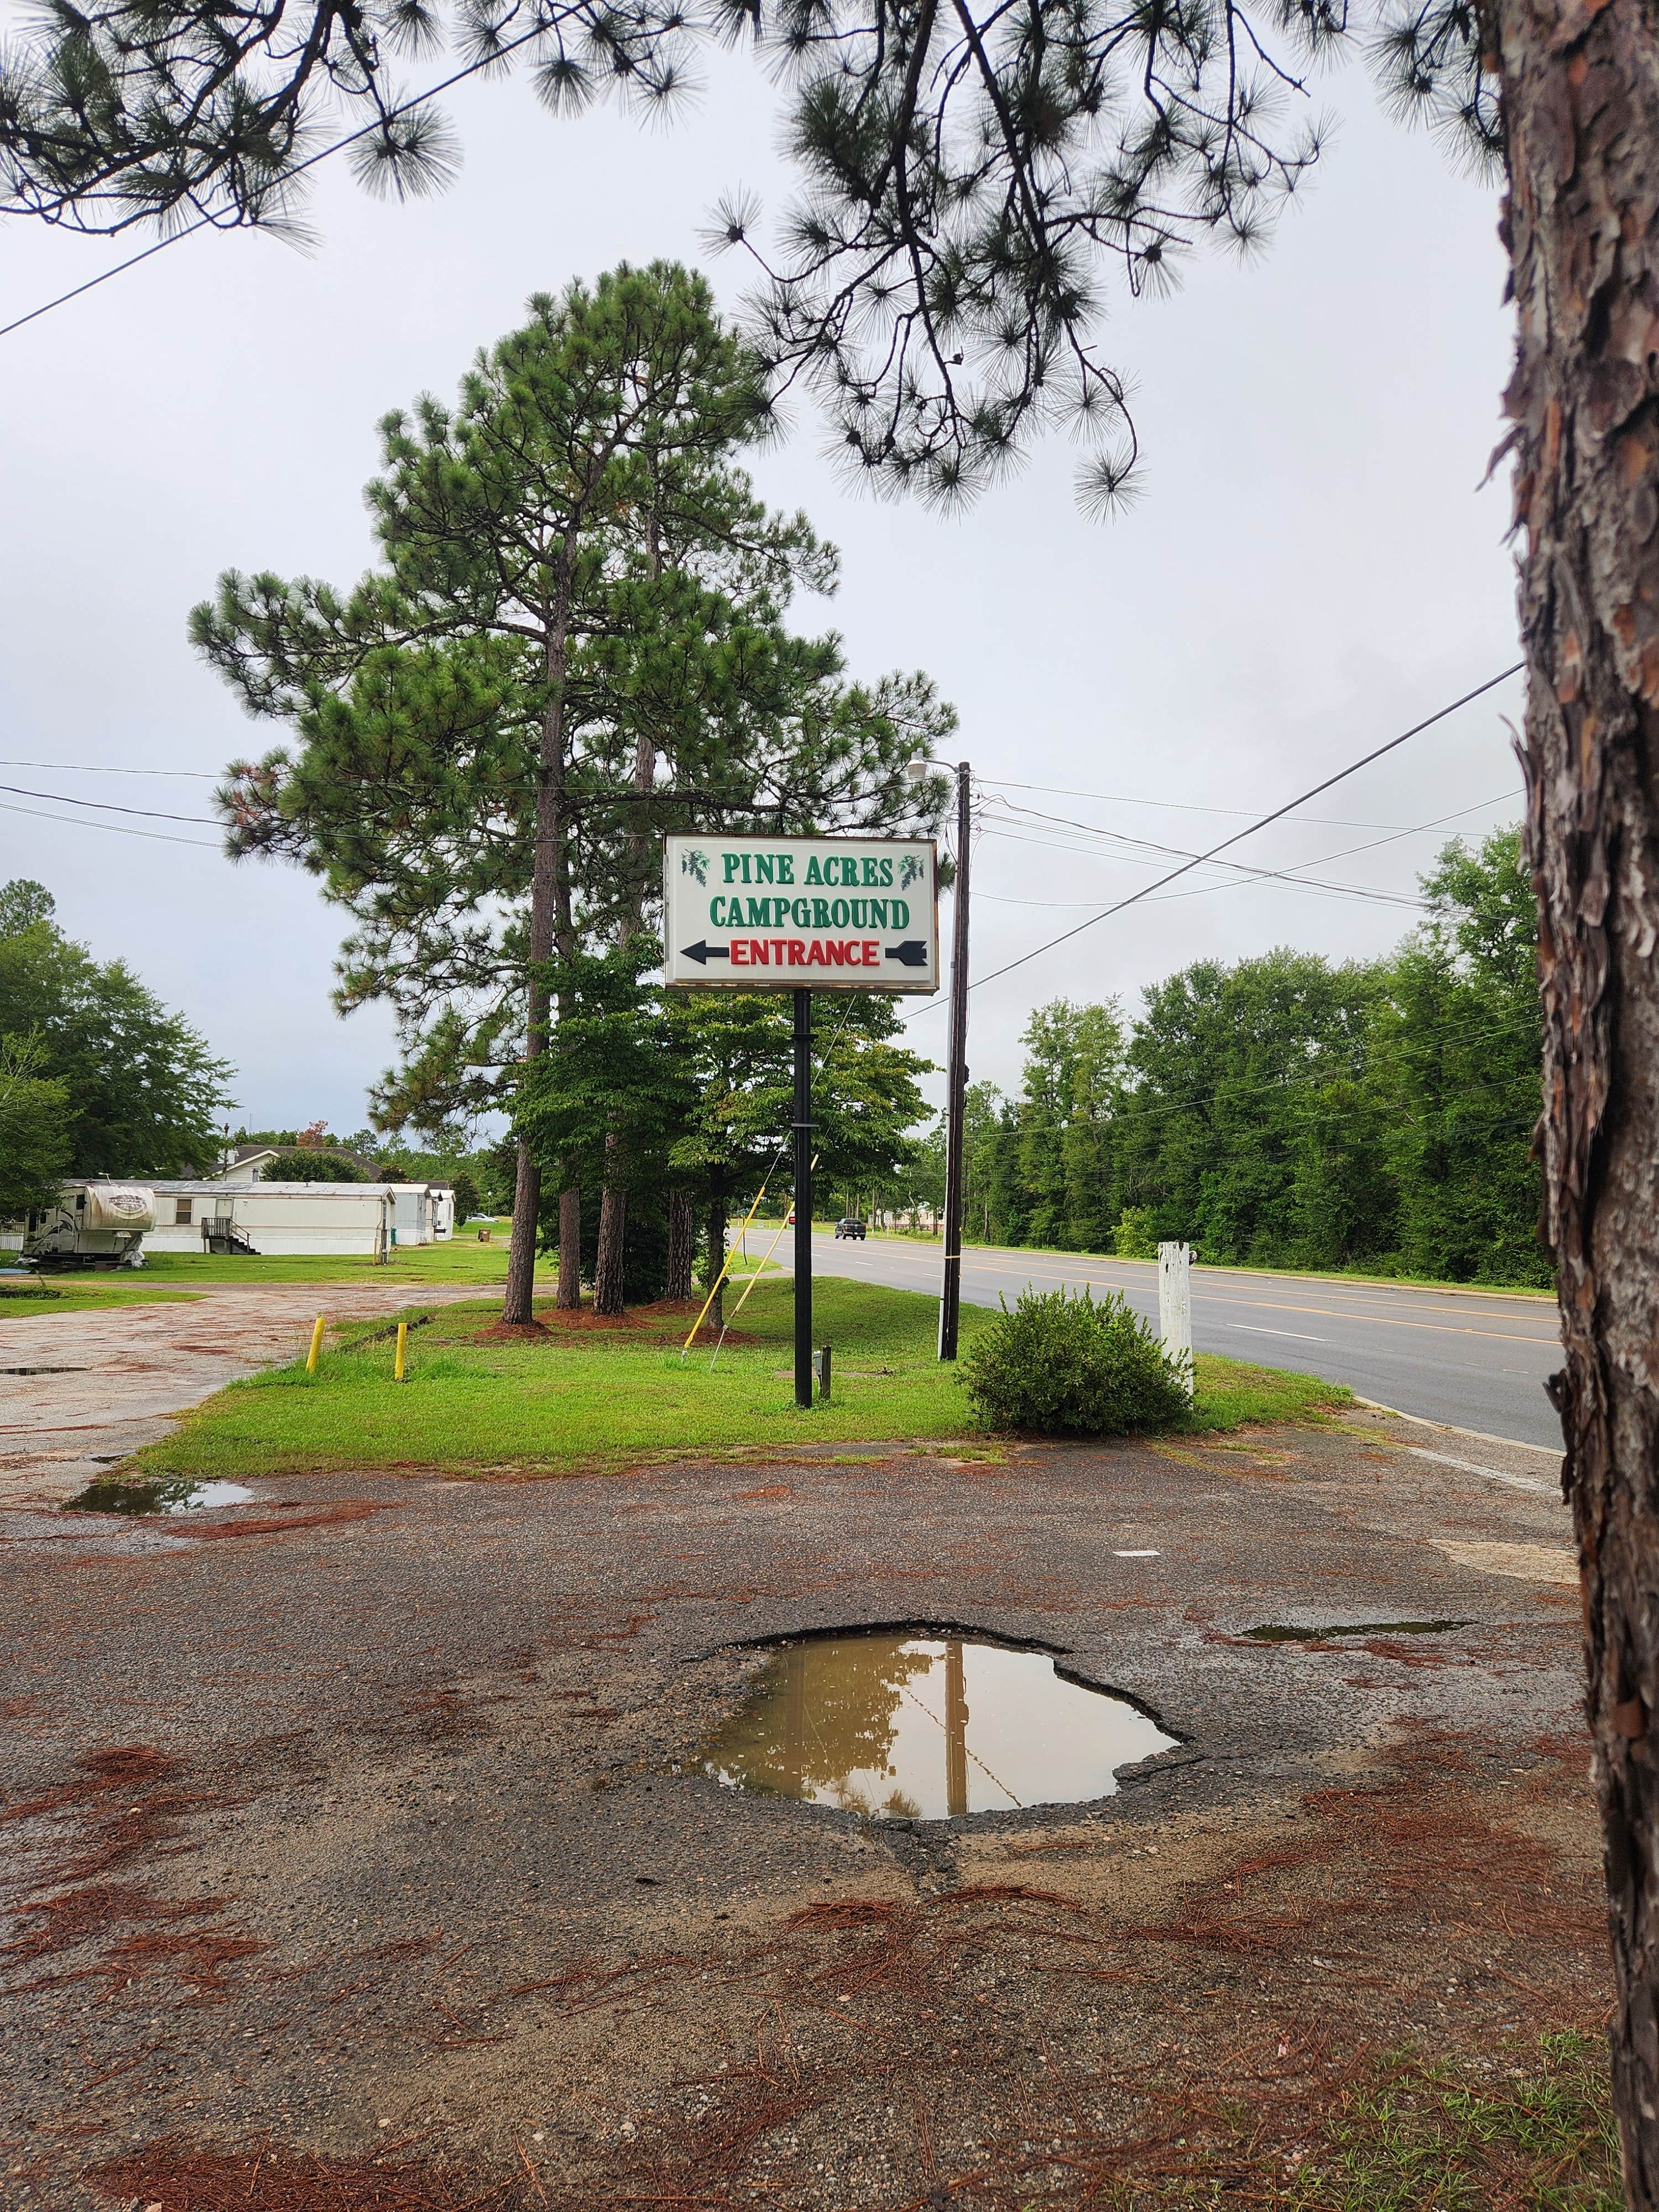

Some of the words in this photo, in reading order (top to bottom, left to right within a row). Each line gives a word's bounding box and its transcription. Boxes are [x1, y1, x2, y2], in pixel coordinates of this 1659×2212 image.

[721, 853, 795, 884] PINE
[804, 855, 894, 886] ACRES
[709, 895, 910, 930] CAMPGROUND
[731, 939, 880, 966] ENTRANCE
